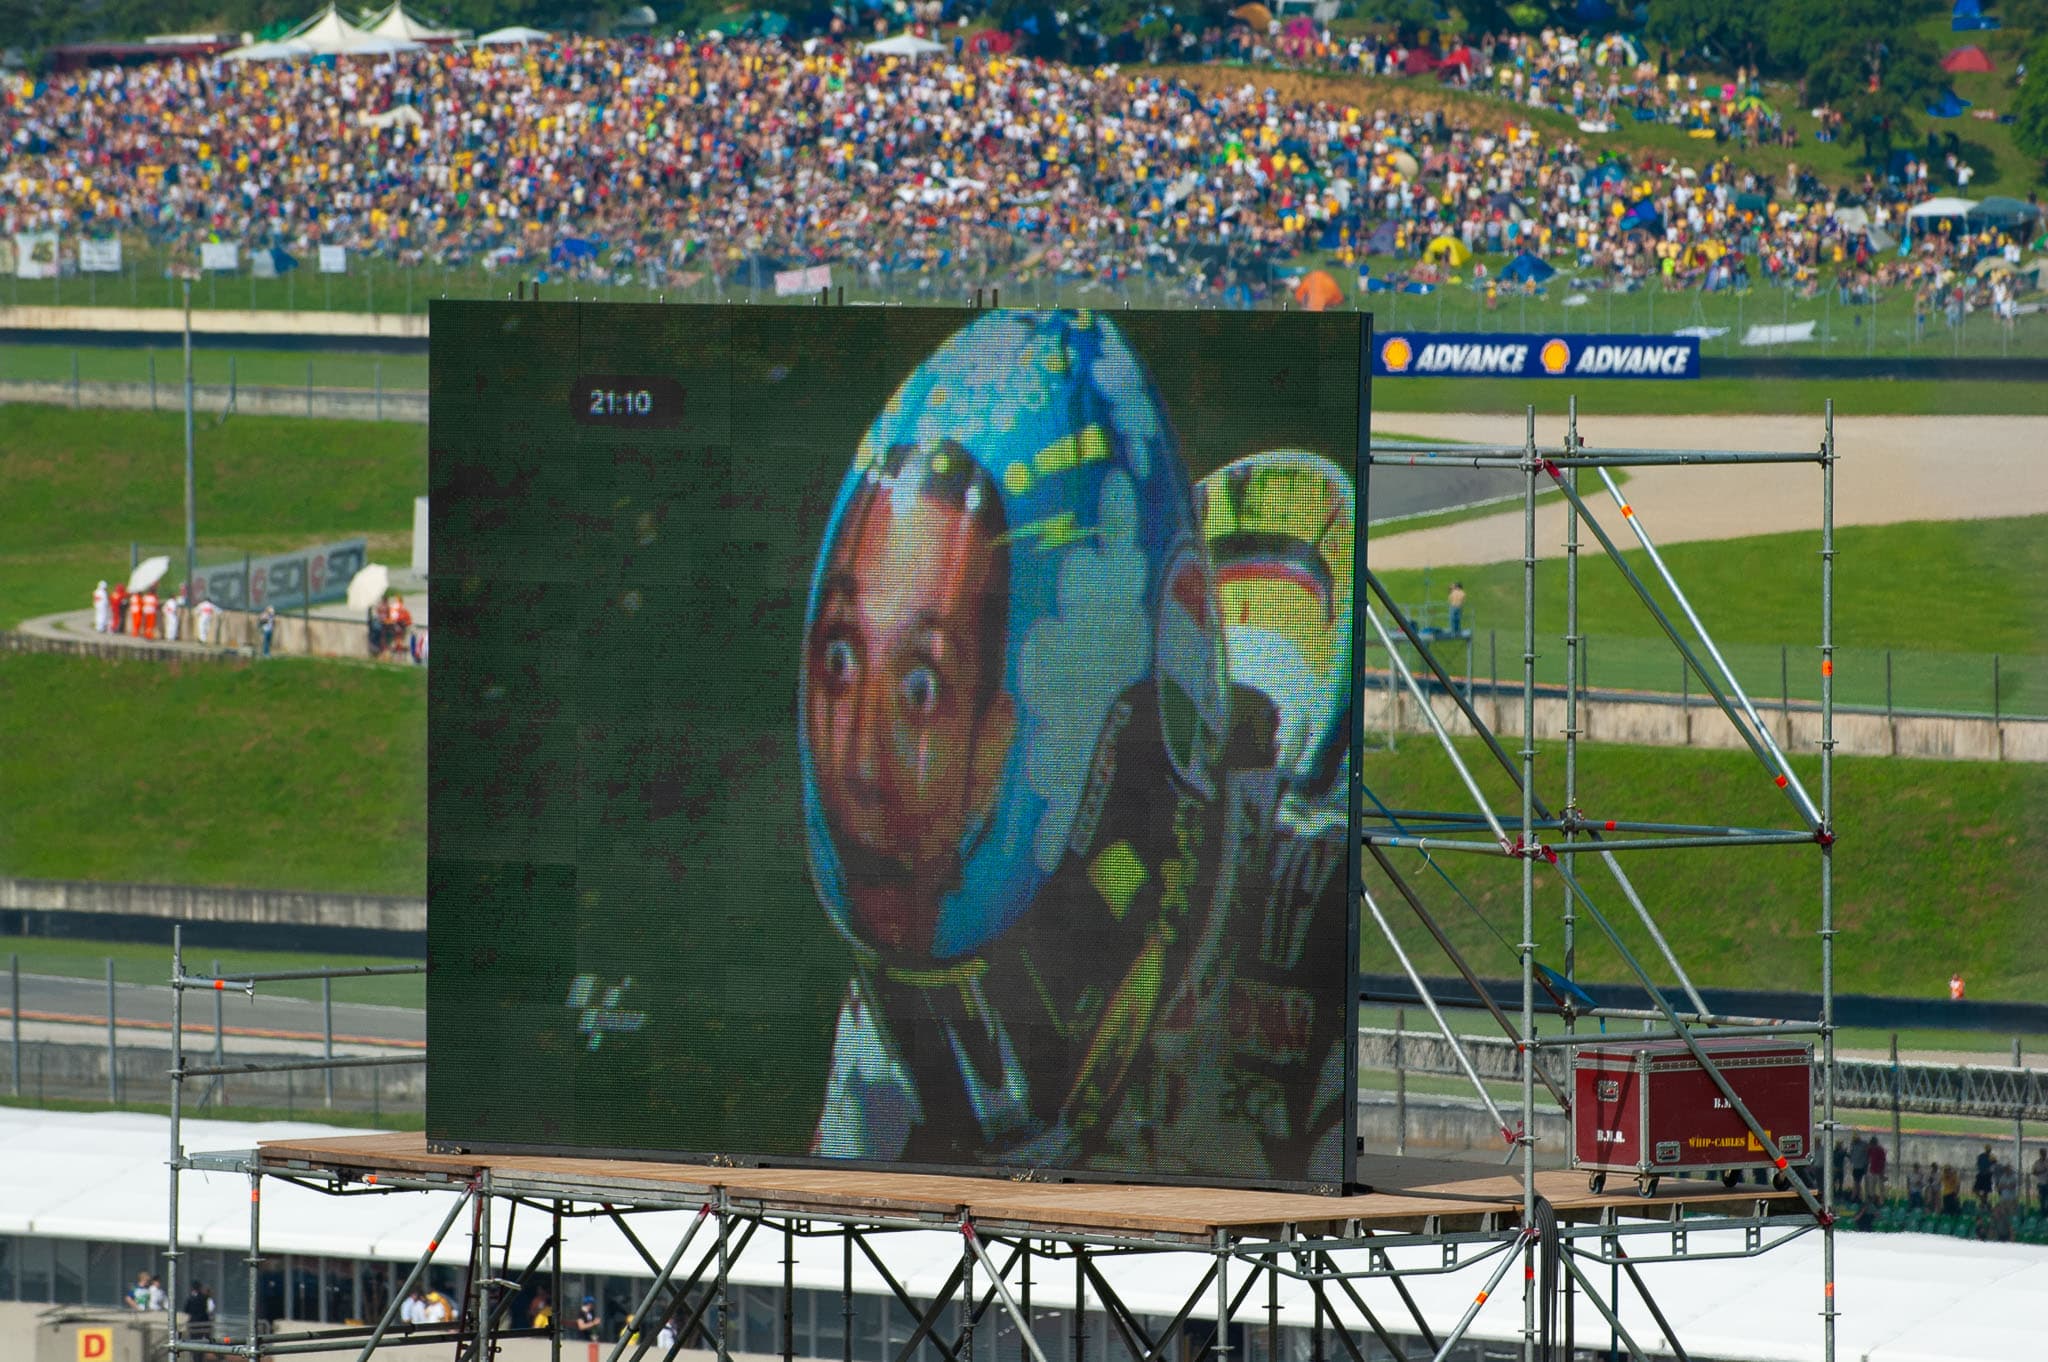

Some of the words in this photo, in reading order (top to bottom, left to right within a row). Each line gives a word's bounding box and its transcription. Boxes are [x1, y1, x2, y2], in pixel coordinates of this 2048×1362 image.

[1415, 343, 1529, 373] ADVANCE
[1575, 345, 1691, 374] ADVANCE
[590, 389, 653, 416] 21:10
[1689, 1136, 1746, 1148] WHIP-CABLES
[84, 1334, 106, 1358] D
